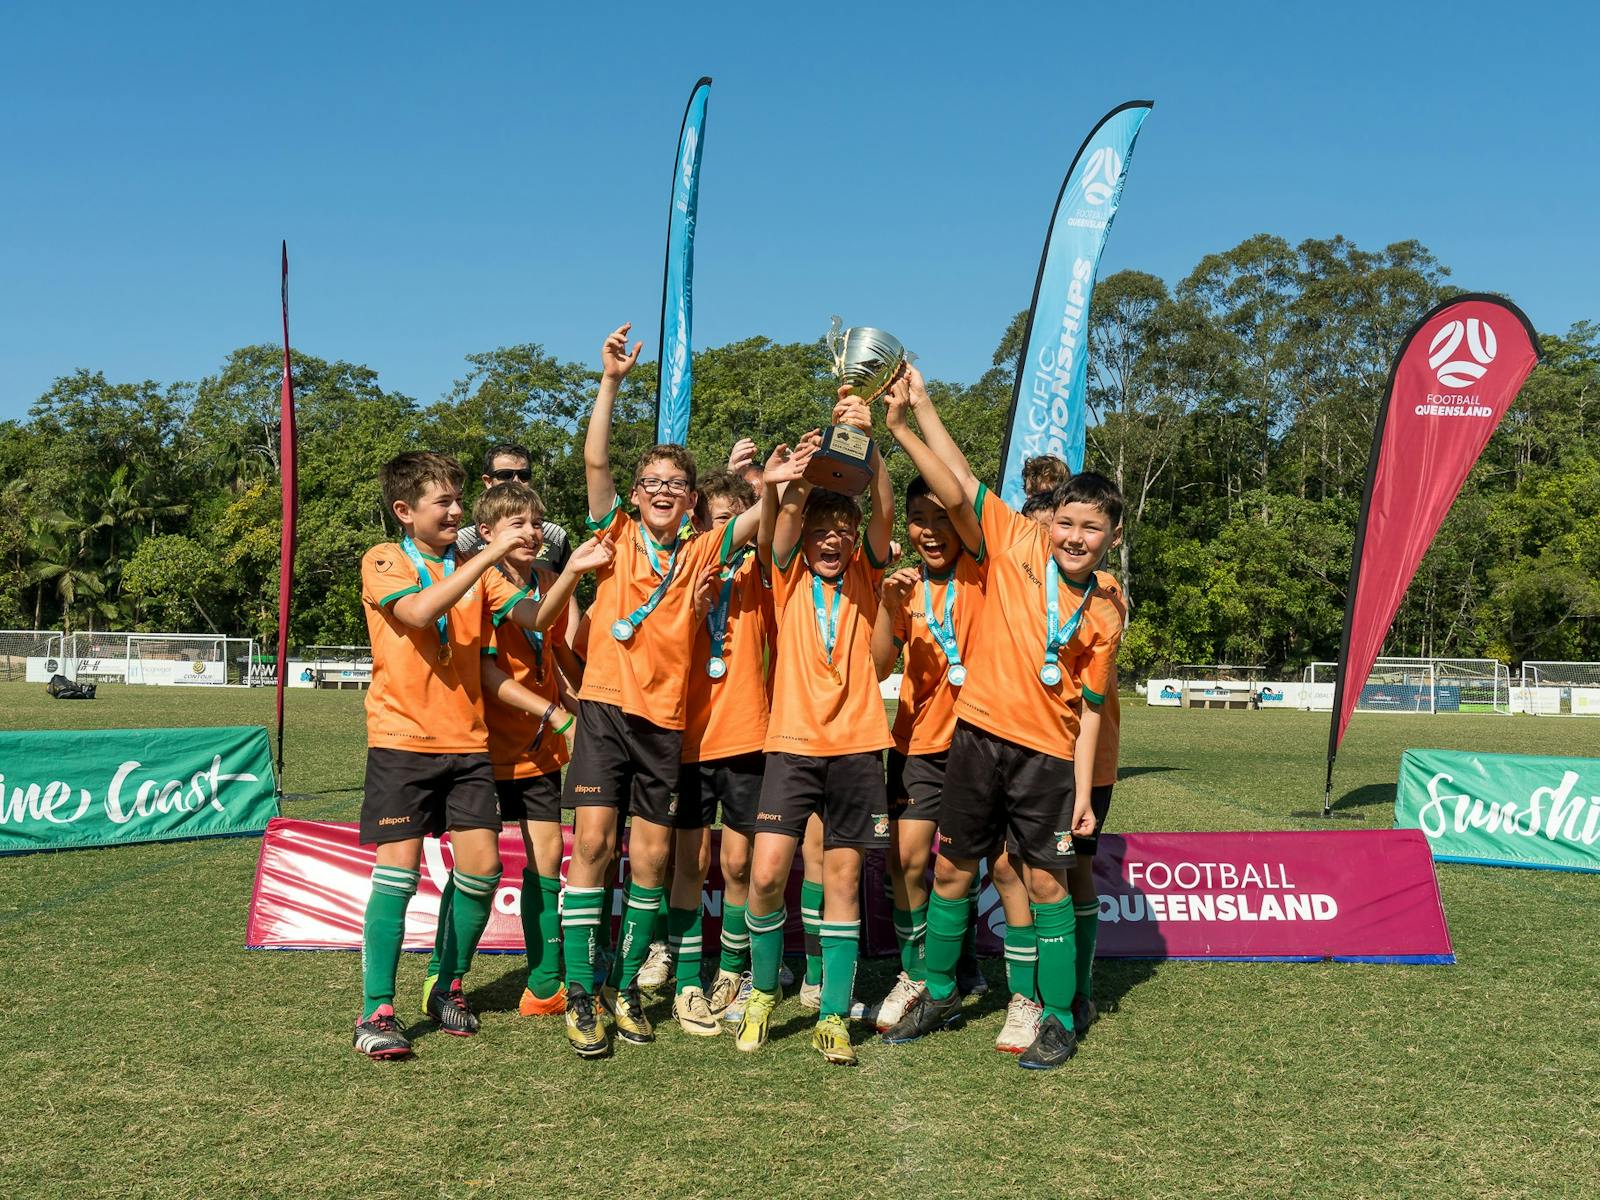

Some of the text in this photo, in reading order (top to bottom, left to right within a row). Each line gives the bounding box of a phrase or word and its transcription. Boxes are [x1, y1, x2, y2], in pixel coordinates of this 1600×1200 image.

[1414, 405, 1493, 417] QUEENSLAND
[1426, 393, 1481, 405] FOOTBALL
[104, 754, 258, 824] Coast
[1127, 862, 1295, 889] FOOTBALL
[1096, 893, 1338, 923] QUEENSLAND
